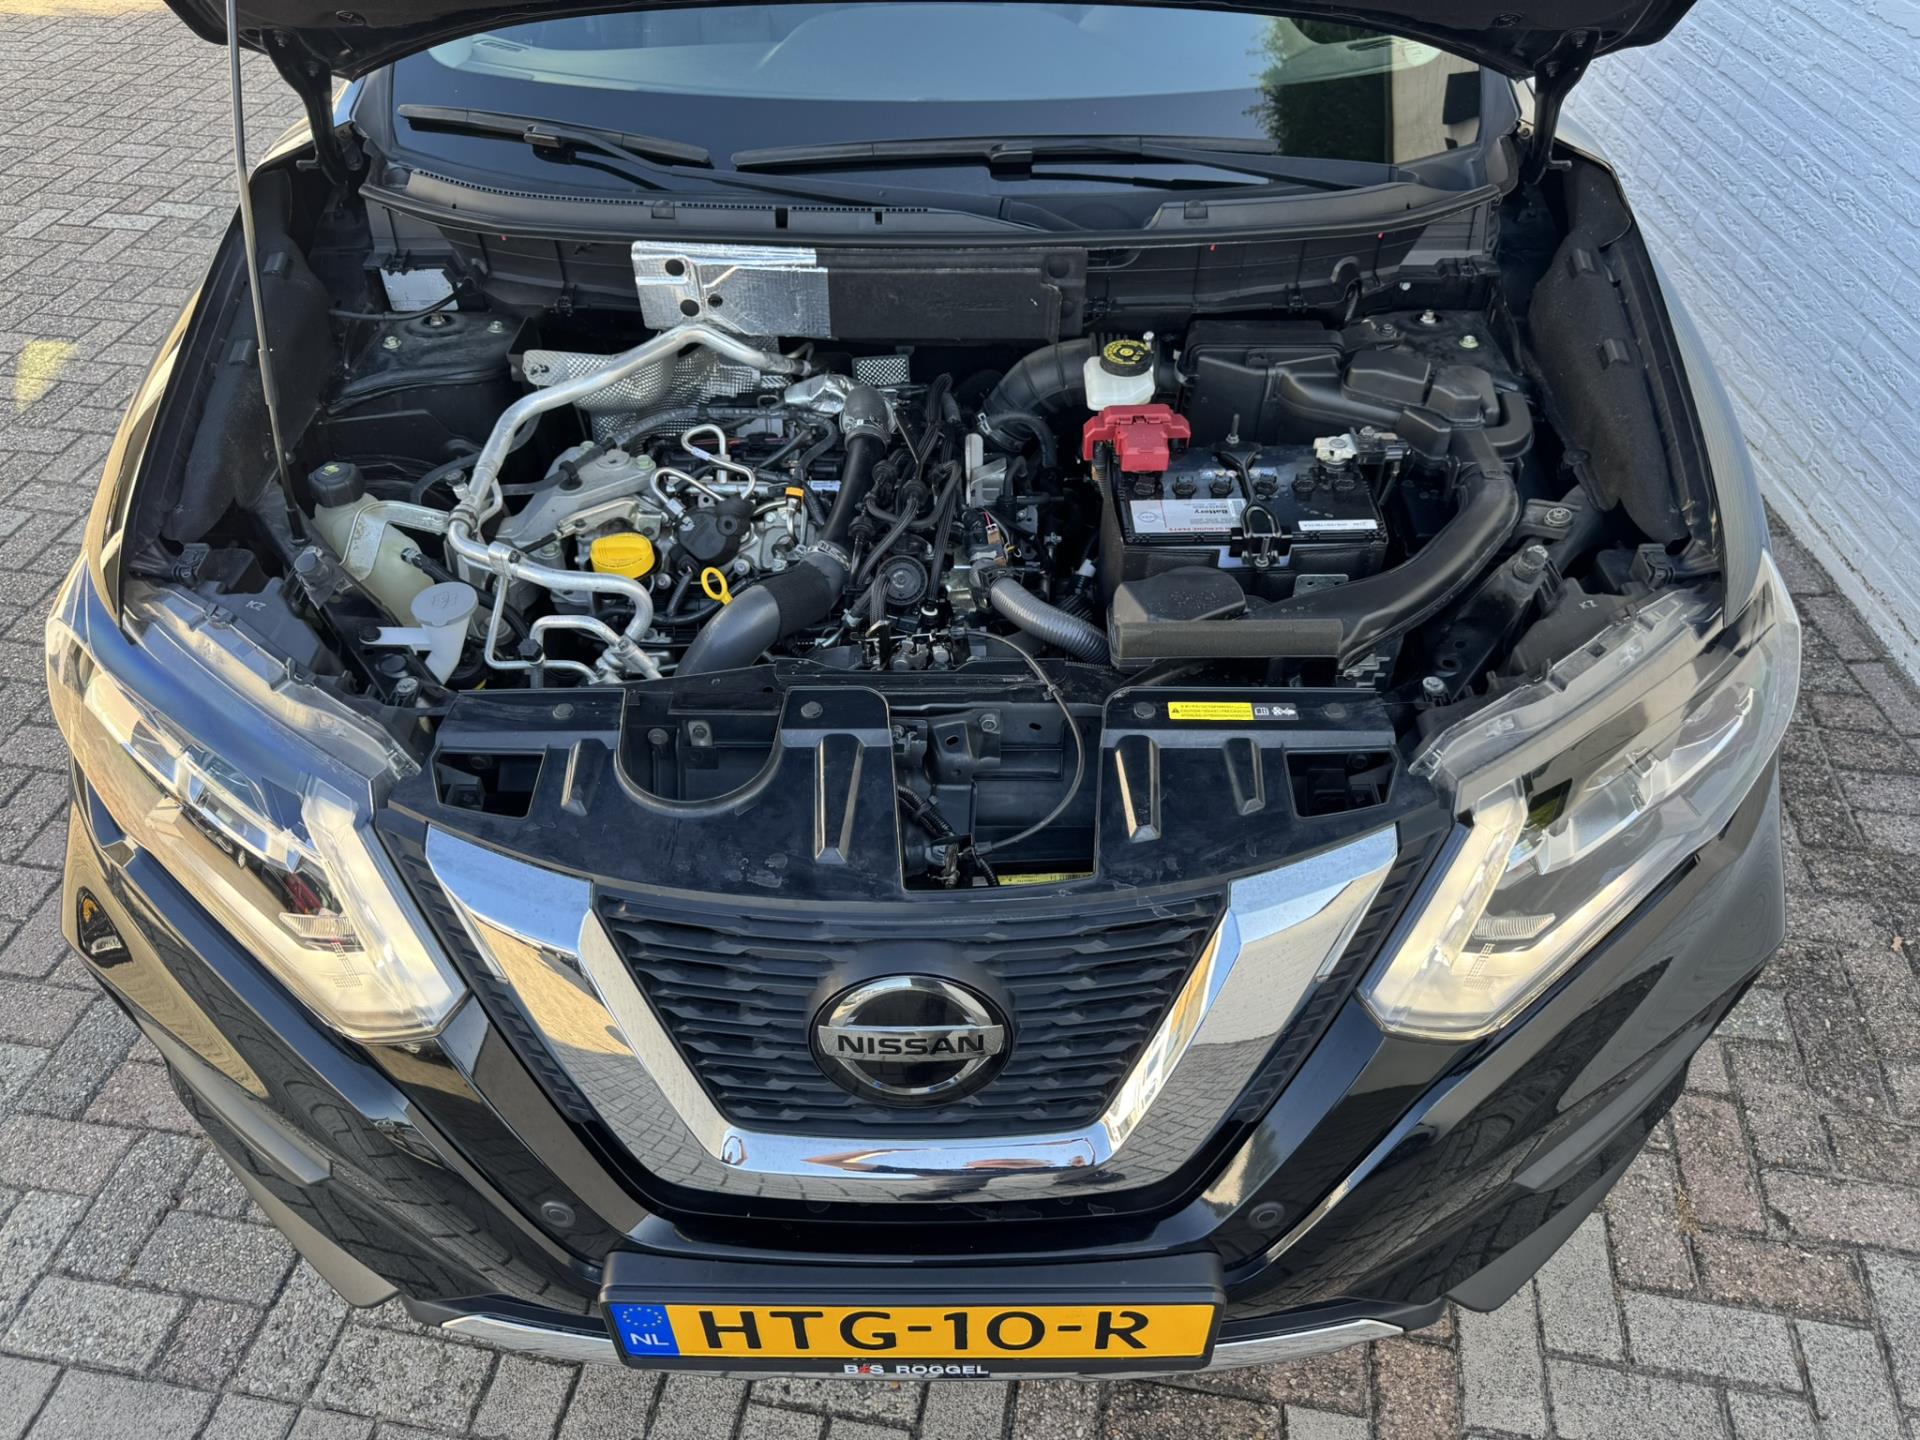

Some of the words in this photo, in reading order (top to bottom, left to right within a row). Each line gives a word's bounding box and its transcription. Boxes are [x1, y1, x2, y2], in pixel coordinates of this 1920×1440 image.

[837, 1034, 985, 1055] NISSAN
[629, 1332, 670, 1347] NL
[698, 1310, 1149, 1351] HTG-10-R
[895, 1364, 990, 1375] ROGGEL
